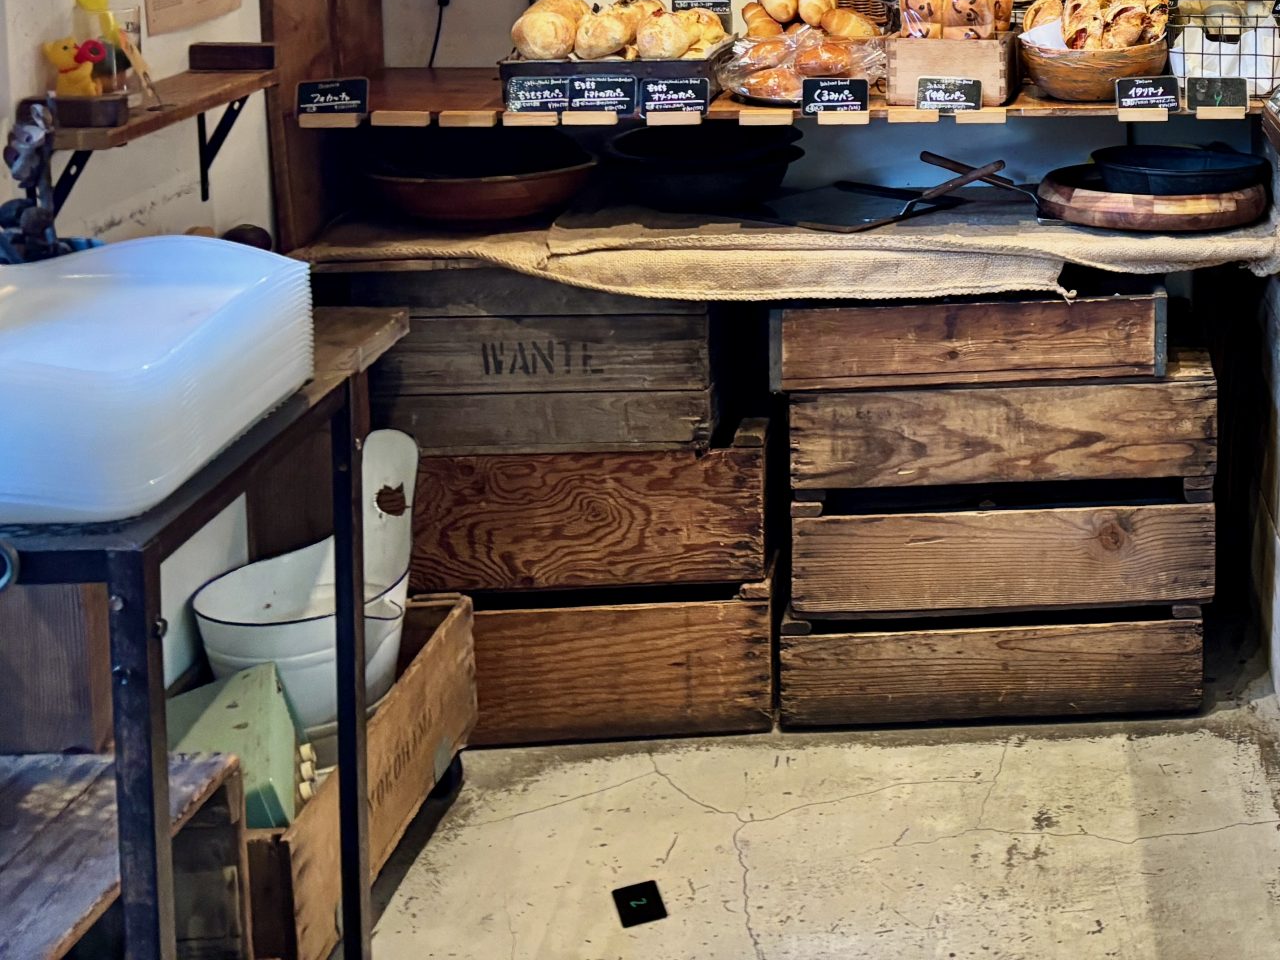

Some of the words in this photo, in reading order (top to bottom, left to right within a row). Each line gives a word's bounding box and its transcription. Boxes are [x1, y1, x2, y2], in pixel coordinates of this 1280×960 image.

[813, 89, 855, 103] くるみパン
